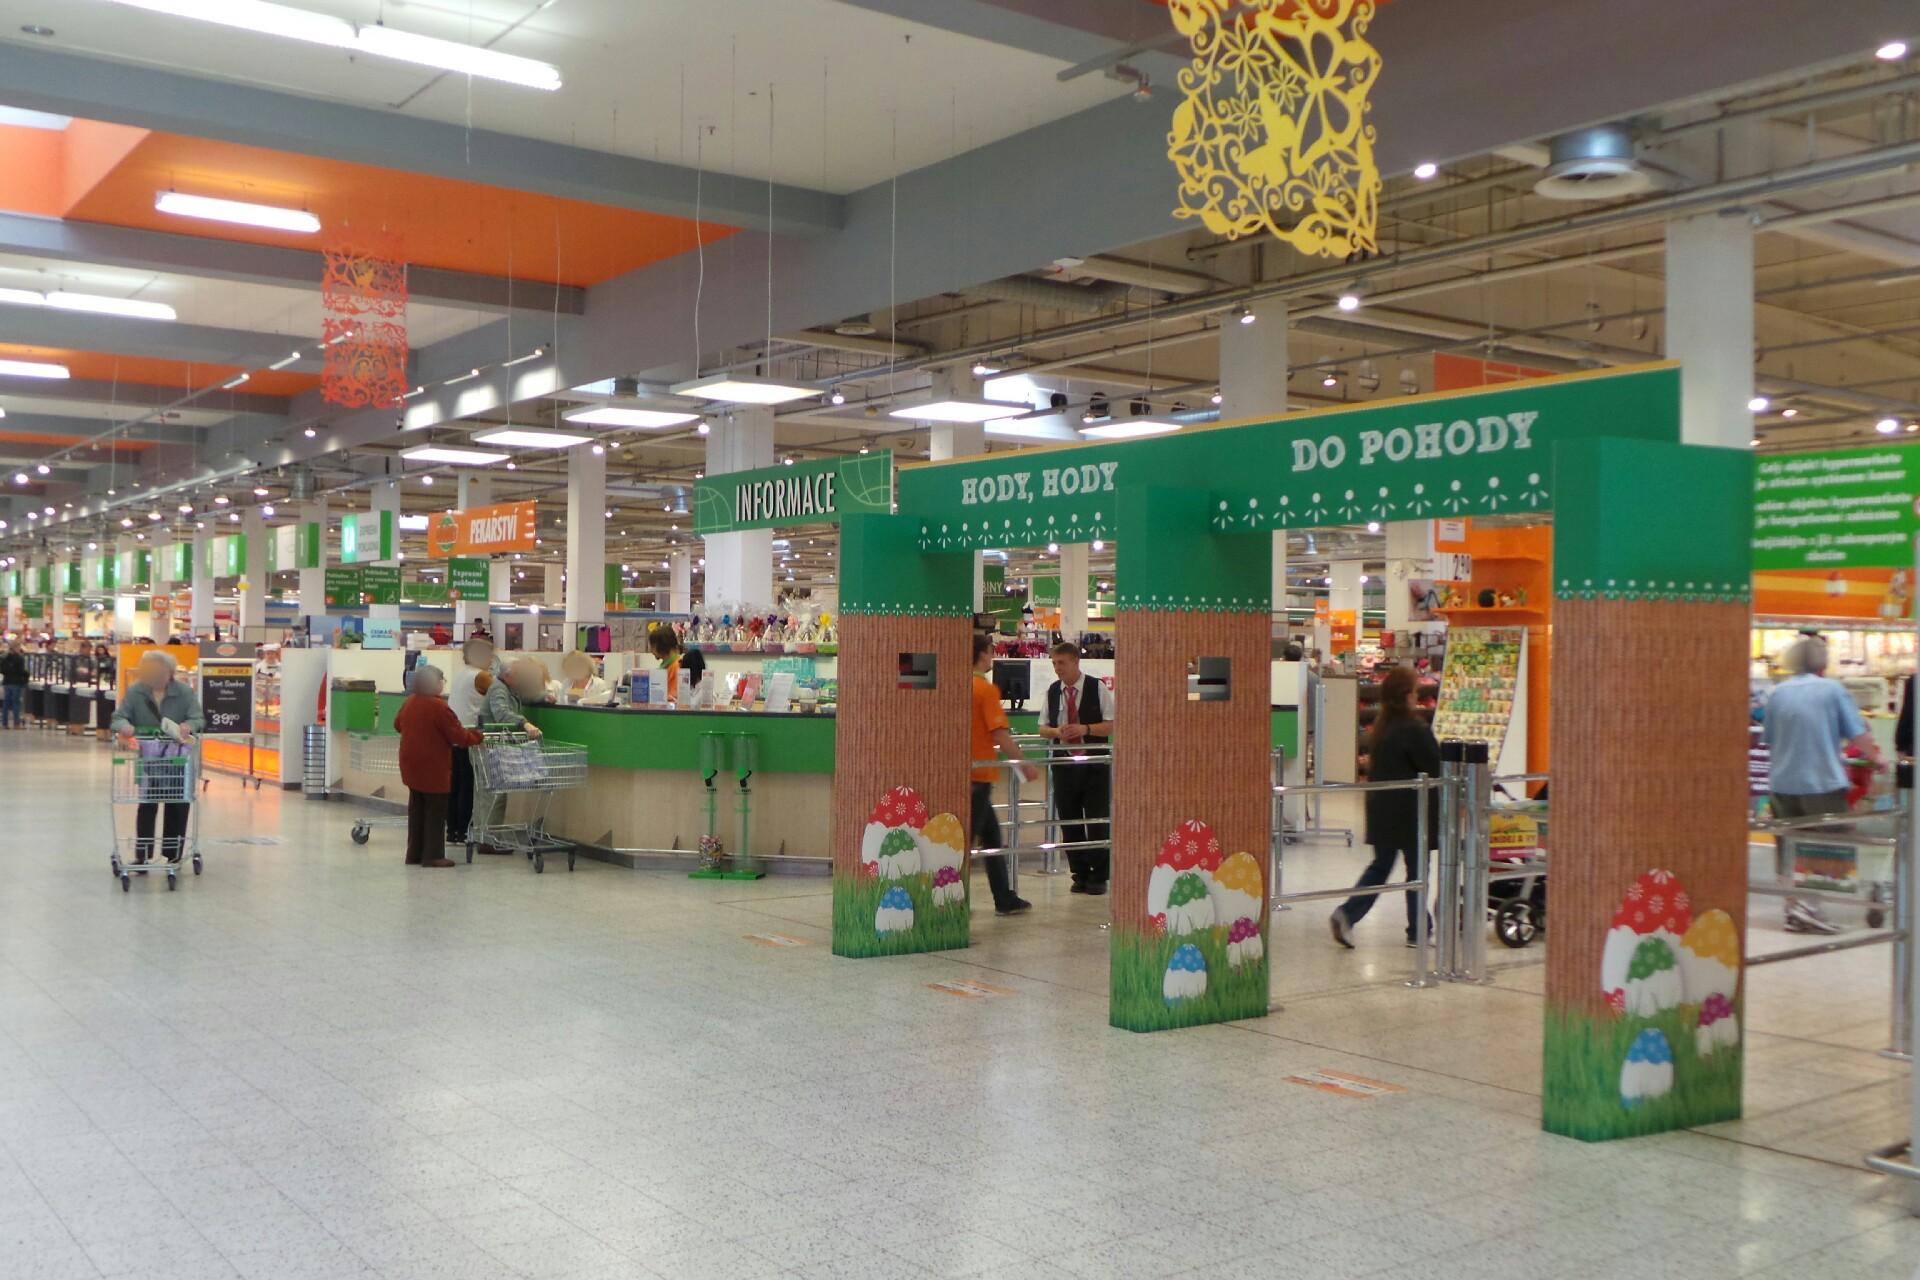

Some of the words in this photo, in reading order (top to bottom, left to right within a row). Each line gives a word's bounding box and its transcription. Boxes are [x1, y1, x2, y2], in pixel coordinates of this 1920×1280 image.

[1291, 435, 1346, 472] DO
[1359, 411, 1539, 465] POHODY
[735, 472, 838, 523] INFORMACE
[962, 471, 1034, 506] HODY,
[1041, 461, 1120, 497] HODY
[470, 508, 518, 544] PEKAŘSTVÍ
